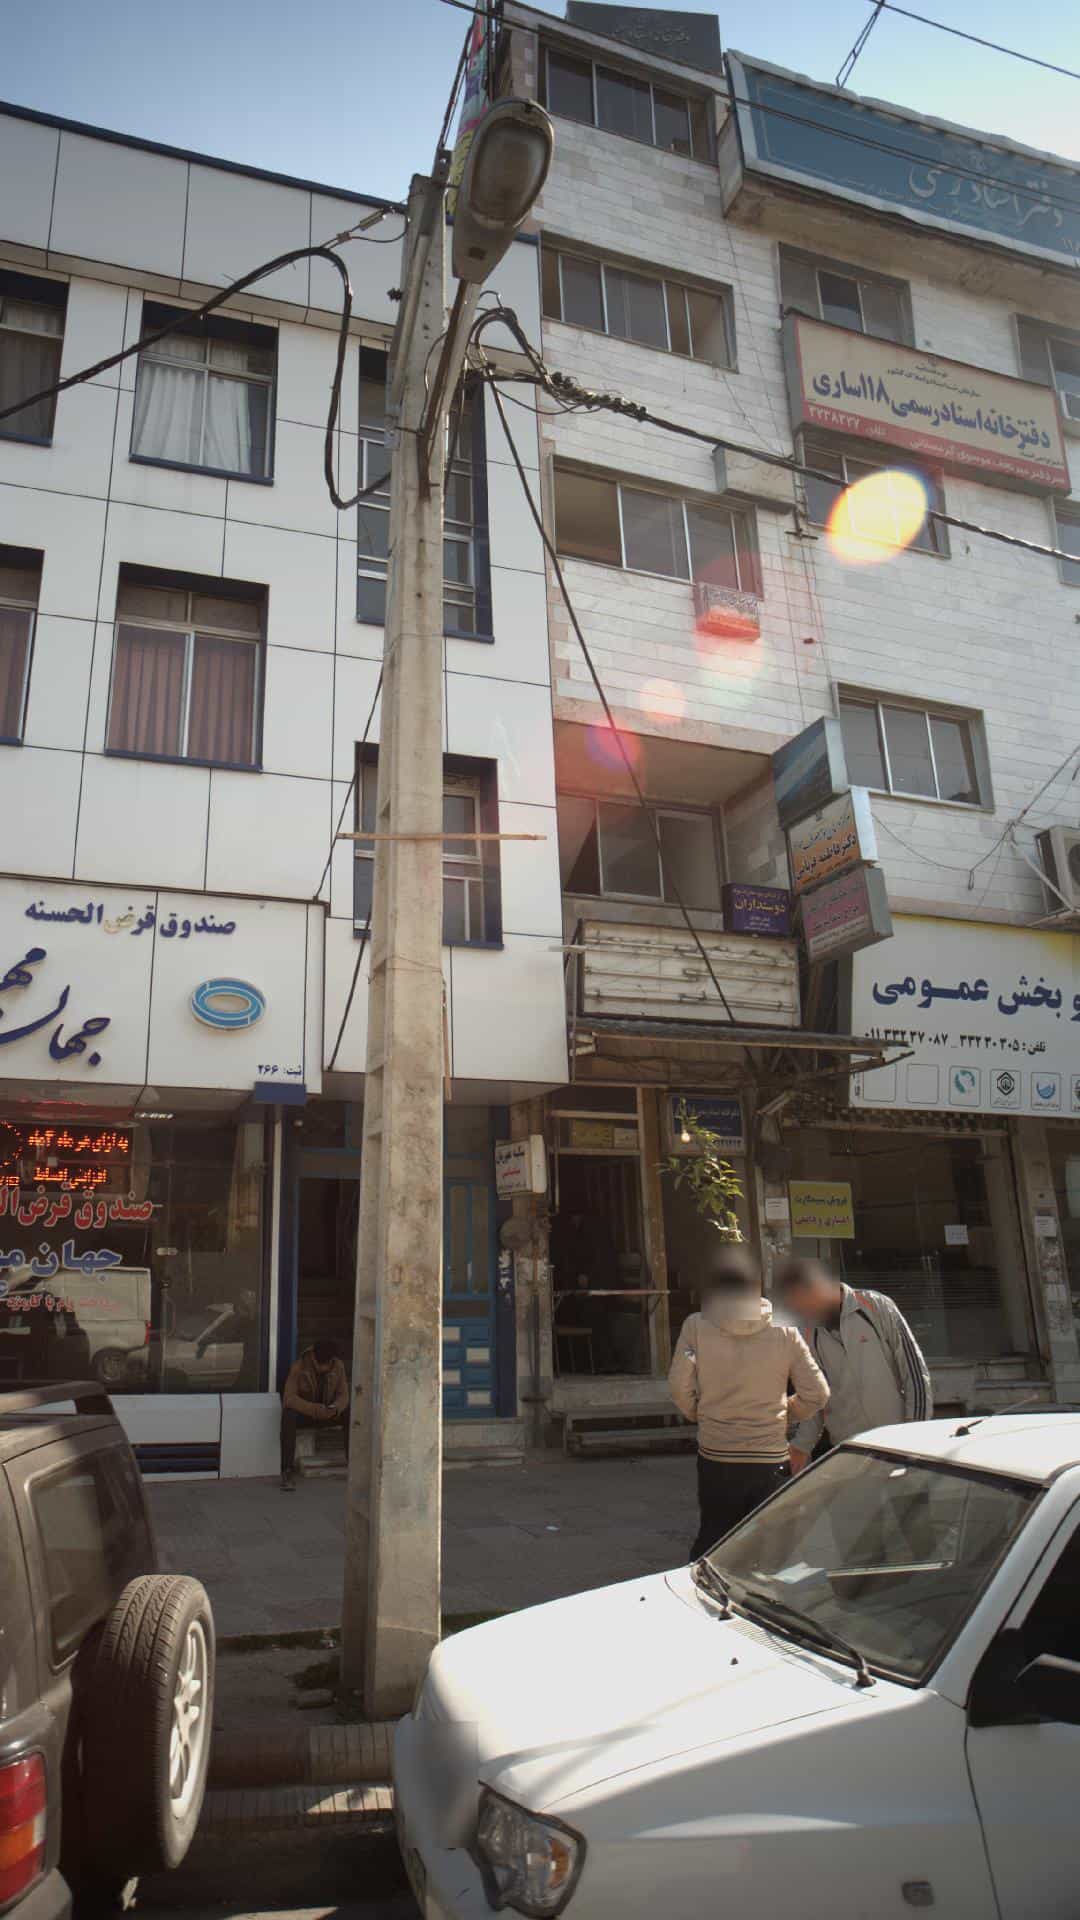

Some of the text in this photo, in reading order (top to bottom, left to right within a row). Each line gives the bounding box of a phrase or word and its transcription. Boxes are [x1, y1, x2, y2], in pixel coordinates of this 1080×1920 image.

[25, 900, 237, 938] صندوق قرض الحسنه
[872, 975, 990, 1009] عمومی
[998, 975, 1063, 1019] بخش
[17, 1180, 73, 1227] قرض
[74, 1189, 154, 1230] صندوق
[30, 1239, 123, 1284] جهان
